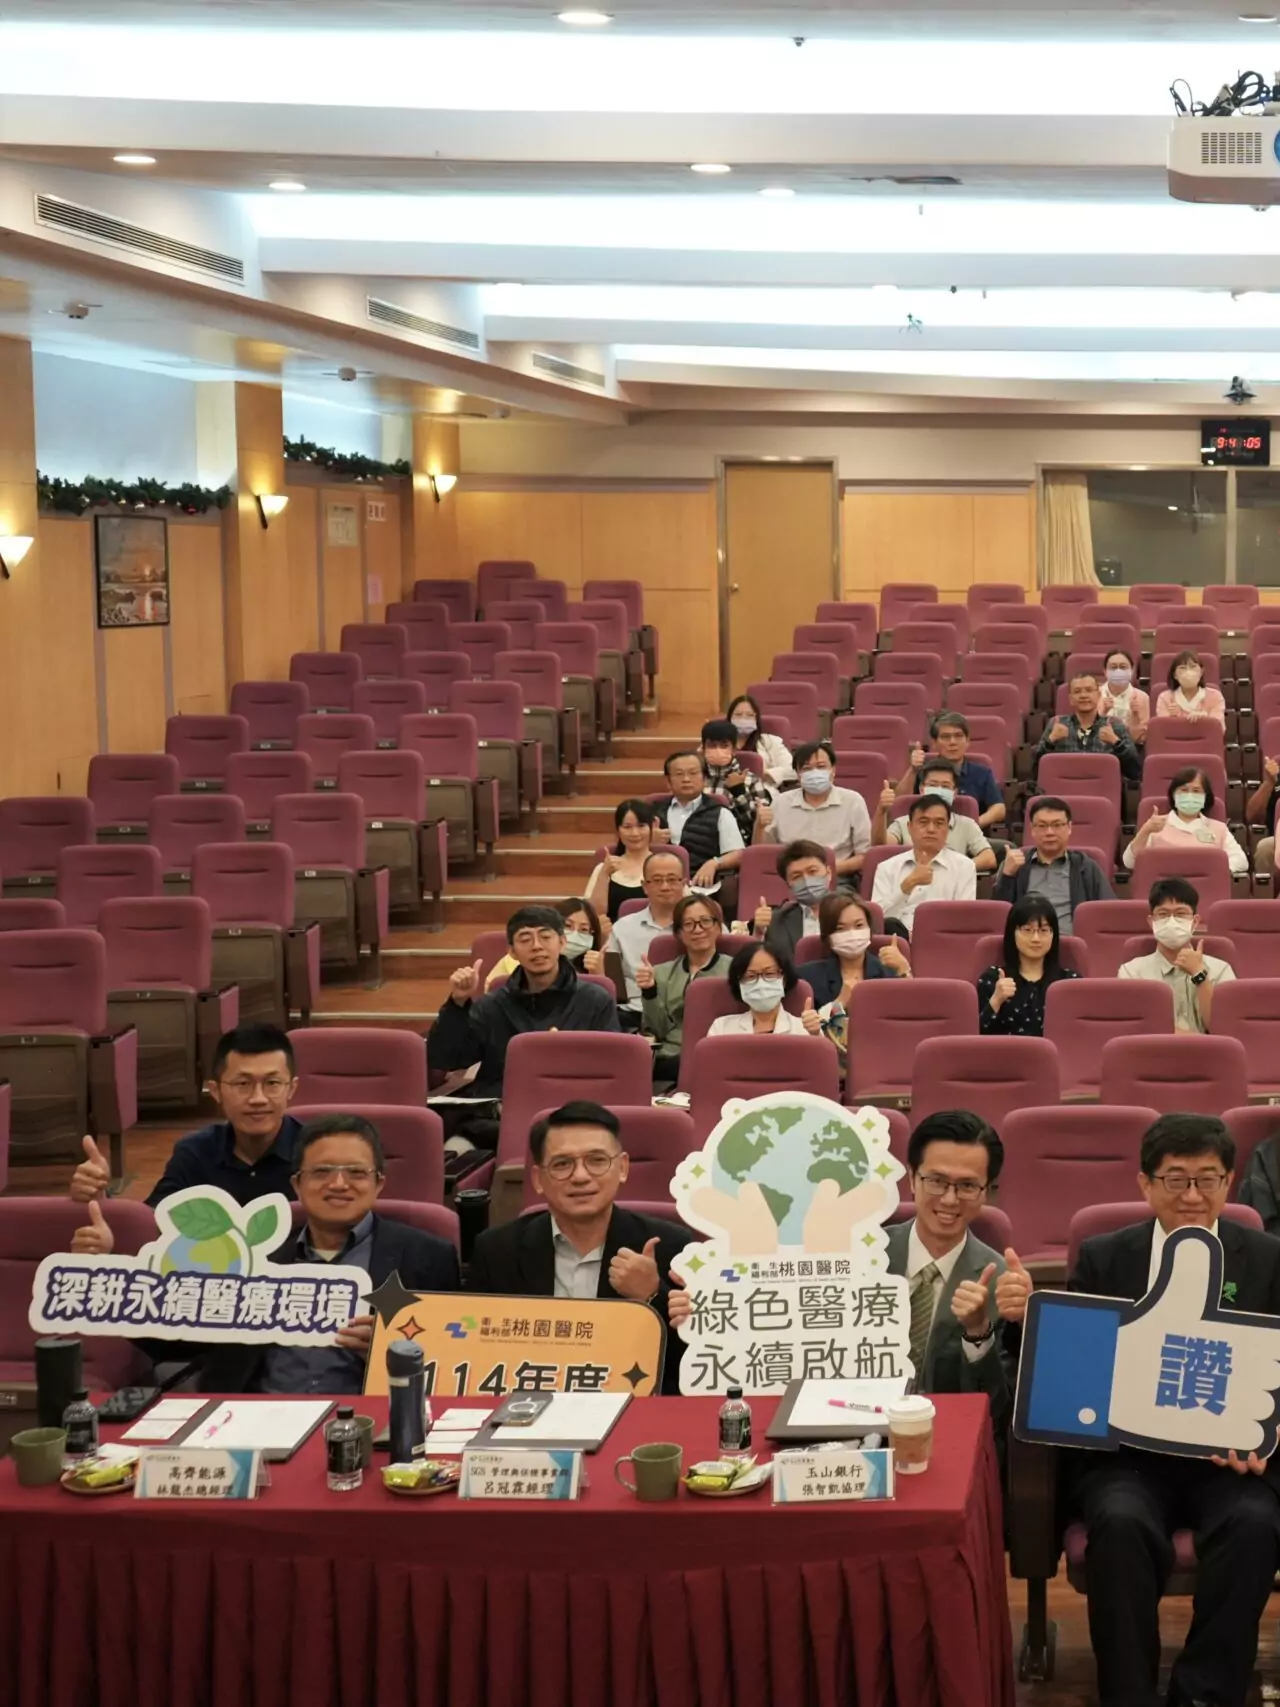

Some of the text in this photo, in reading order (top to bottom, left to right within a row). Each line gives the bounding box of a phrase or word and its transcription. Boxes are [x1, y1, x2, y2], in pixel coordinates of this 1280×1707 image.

[779, 1259, 851, 1277] 桃園醫院
[47, 1271, 353, 1328] 深耕永續醫療環境
[690, 1283, 901, 1335] 綠色醫療
[512, 1318, 593, 1339] 桃園醫院
[424, 1361, 610, 1396] 114年度
[690, 1336, 904, 1391] 永續啟航
[1155, 1333, 1233, 1416] 讚
[805, 1464, 863, 1479] 玉山銀行
